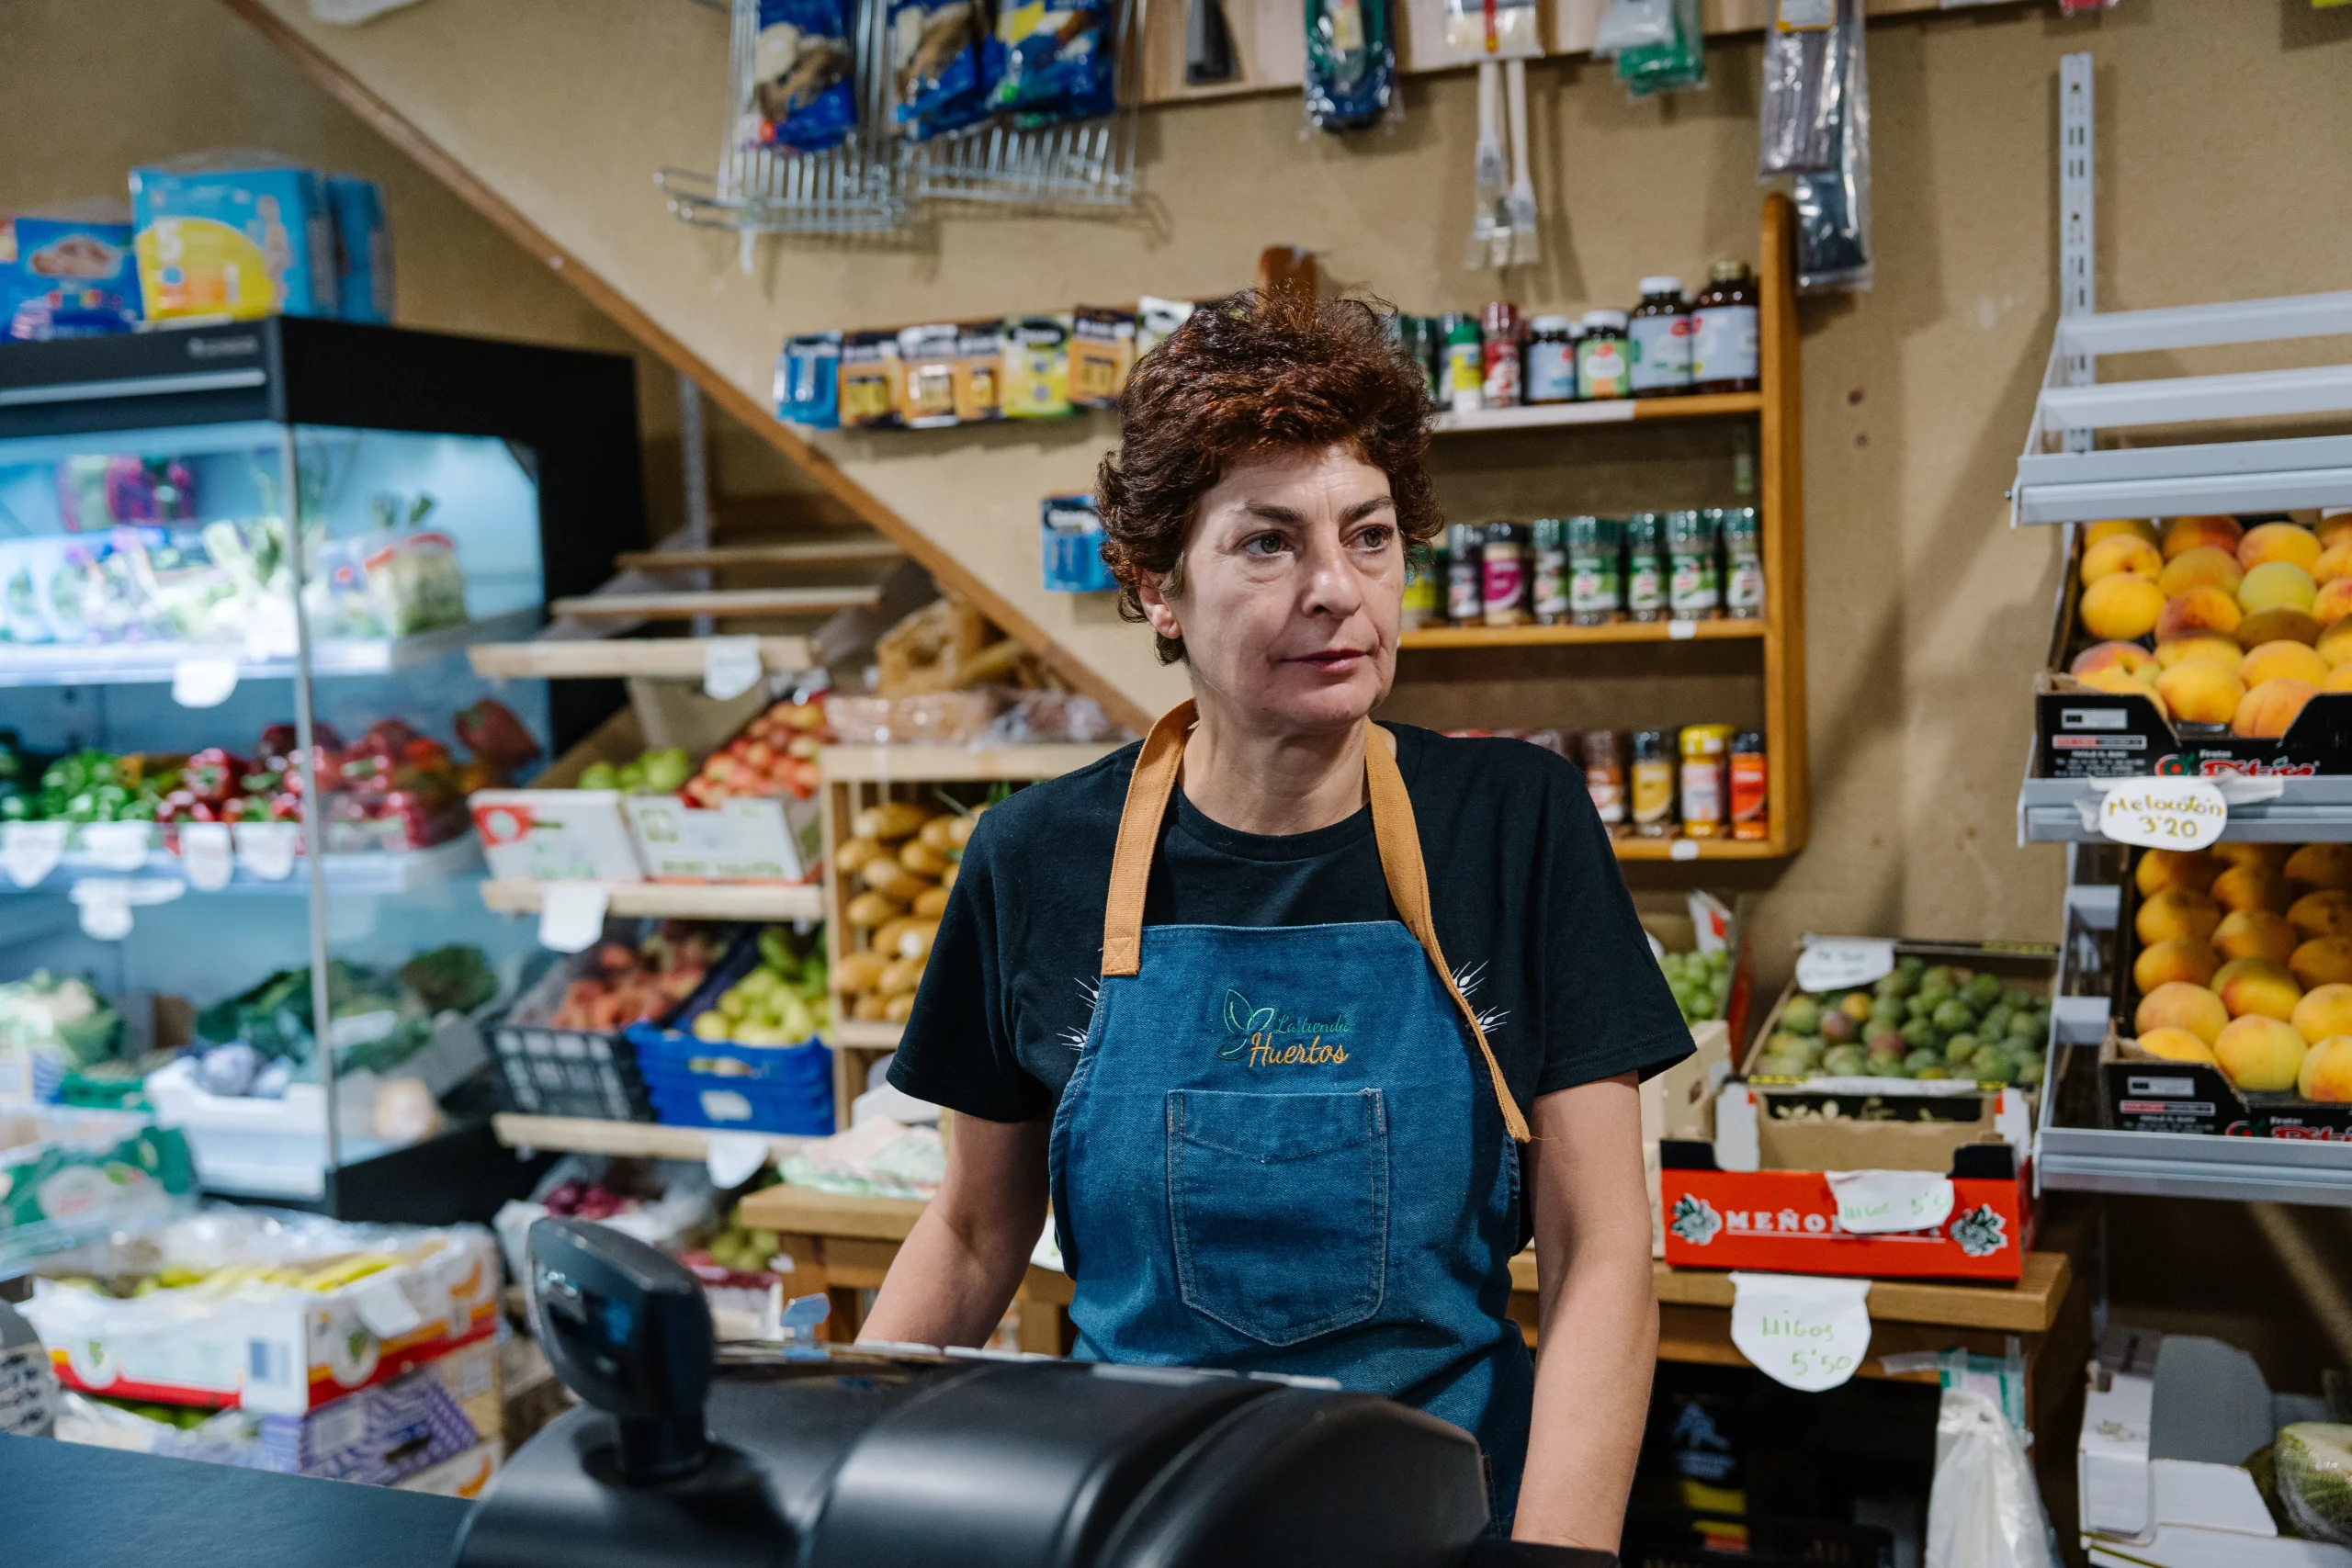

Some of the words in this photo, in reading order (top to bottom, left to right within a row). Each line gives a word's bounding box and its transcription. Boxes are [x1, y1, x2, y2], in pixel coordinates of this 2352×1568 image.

[1272, 1014, 1296, 1033] La
[1302, 1014, 1349, 1033] tienda
[1249, 1032, 1350, 1067] Huertos
